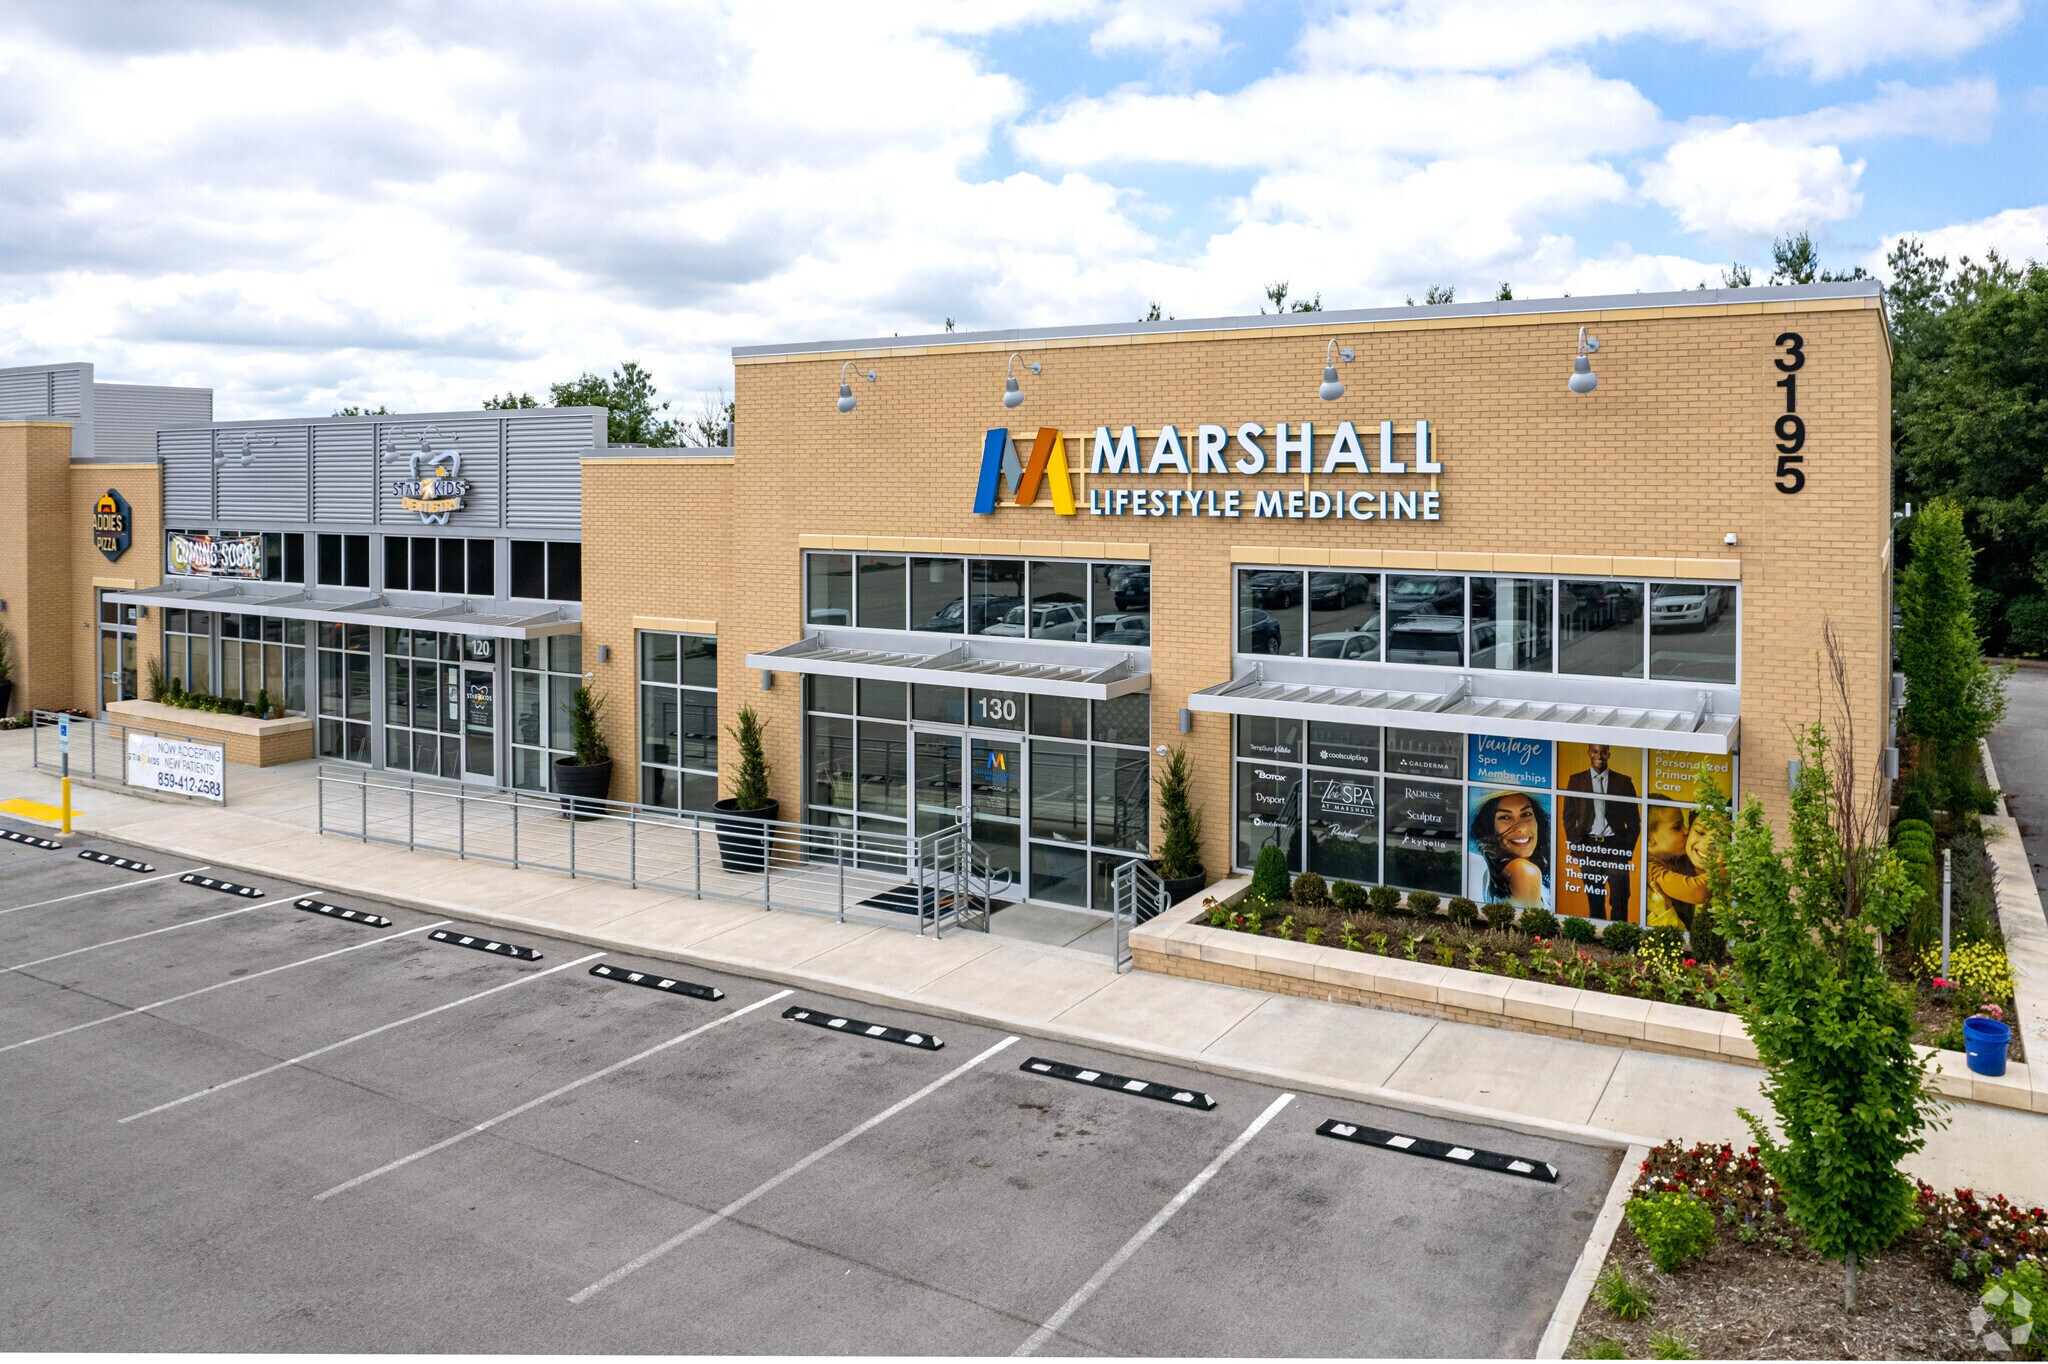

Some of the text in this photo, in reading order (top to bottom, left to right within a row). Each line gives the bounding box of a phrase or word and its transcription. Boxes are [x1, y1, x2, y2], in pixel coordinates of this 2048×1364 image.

[1774, 332, 1806, 495] 3195
[1089, 420, 1443, 475] MARSHALL
[393, 482, 420, 496] STAR
[1089, 488, 1441, 521] LIFESTYLE MEDICINE
[97, 536, 117, 552] PIZZA
[175, 540, 253, 568] COMING SOON
[471, 639, 490, 656] 120
[979, 697, 1016, 720] 130
[158, 742, 220, 762] NOW ACCEPTING
[1328, 751, 1369, 764] coolsculpting
[1478, 734, 1543, 766] Vantage
[164, 757, 215, 776] NEW PATIENTS
[1408, 760, 1450, 770] GALDERMA
[1478, 754, 1498, 766] Spa
[157, 771, 221, 797] 859-412-2583
[1477, 767, 1547, 785] Memberships
[1313, 779, 1375, 807] The SPA
[1405, 787, 1443, 800] RADIESSE
[1655, 780, 1682, 792] Care
[1255, 792, 1285, 805] Dysport
[1333, 804, 1374, 815] MARSHALL
[1407, 809, 1442, 824] Sculptra
[1411, 837, 1447, 849] kybella
[1565, 840, 1633, 857] Testosterone
[1565, 854, 1636, 871] Replacement
[1565, 868, 1609, 885] Therapy
[1565, 881, 1608, 896] for Men
